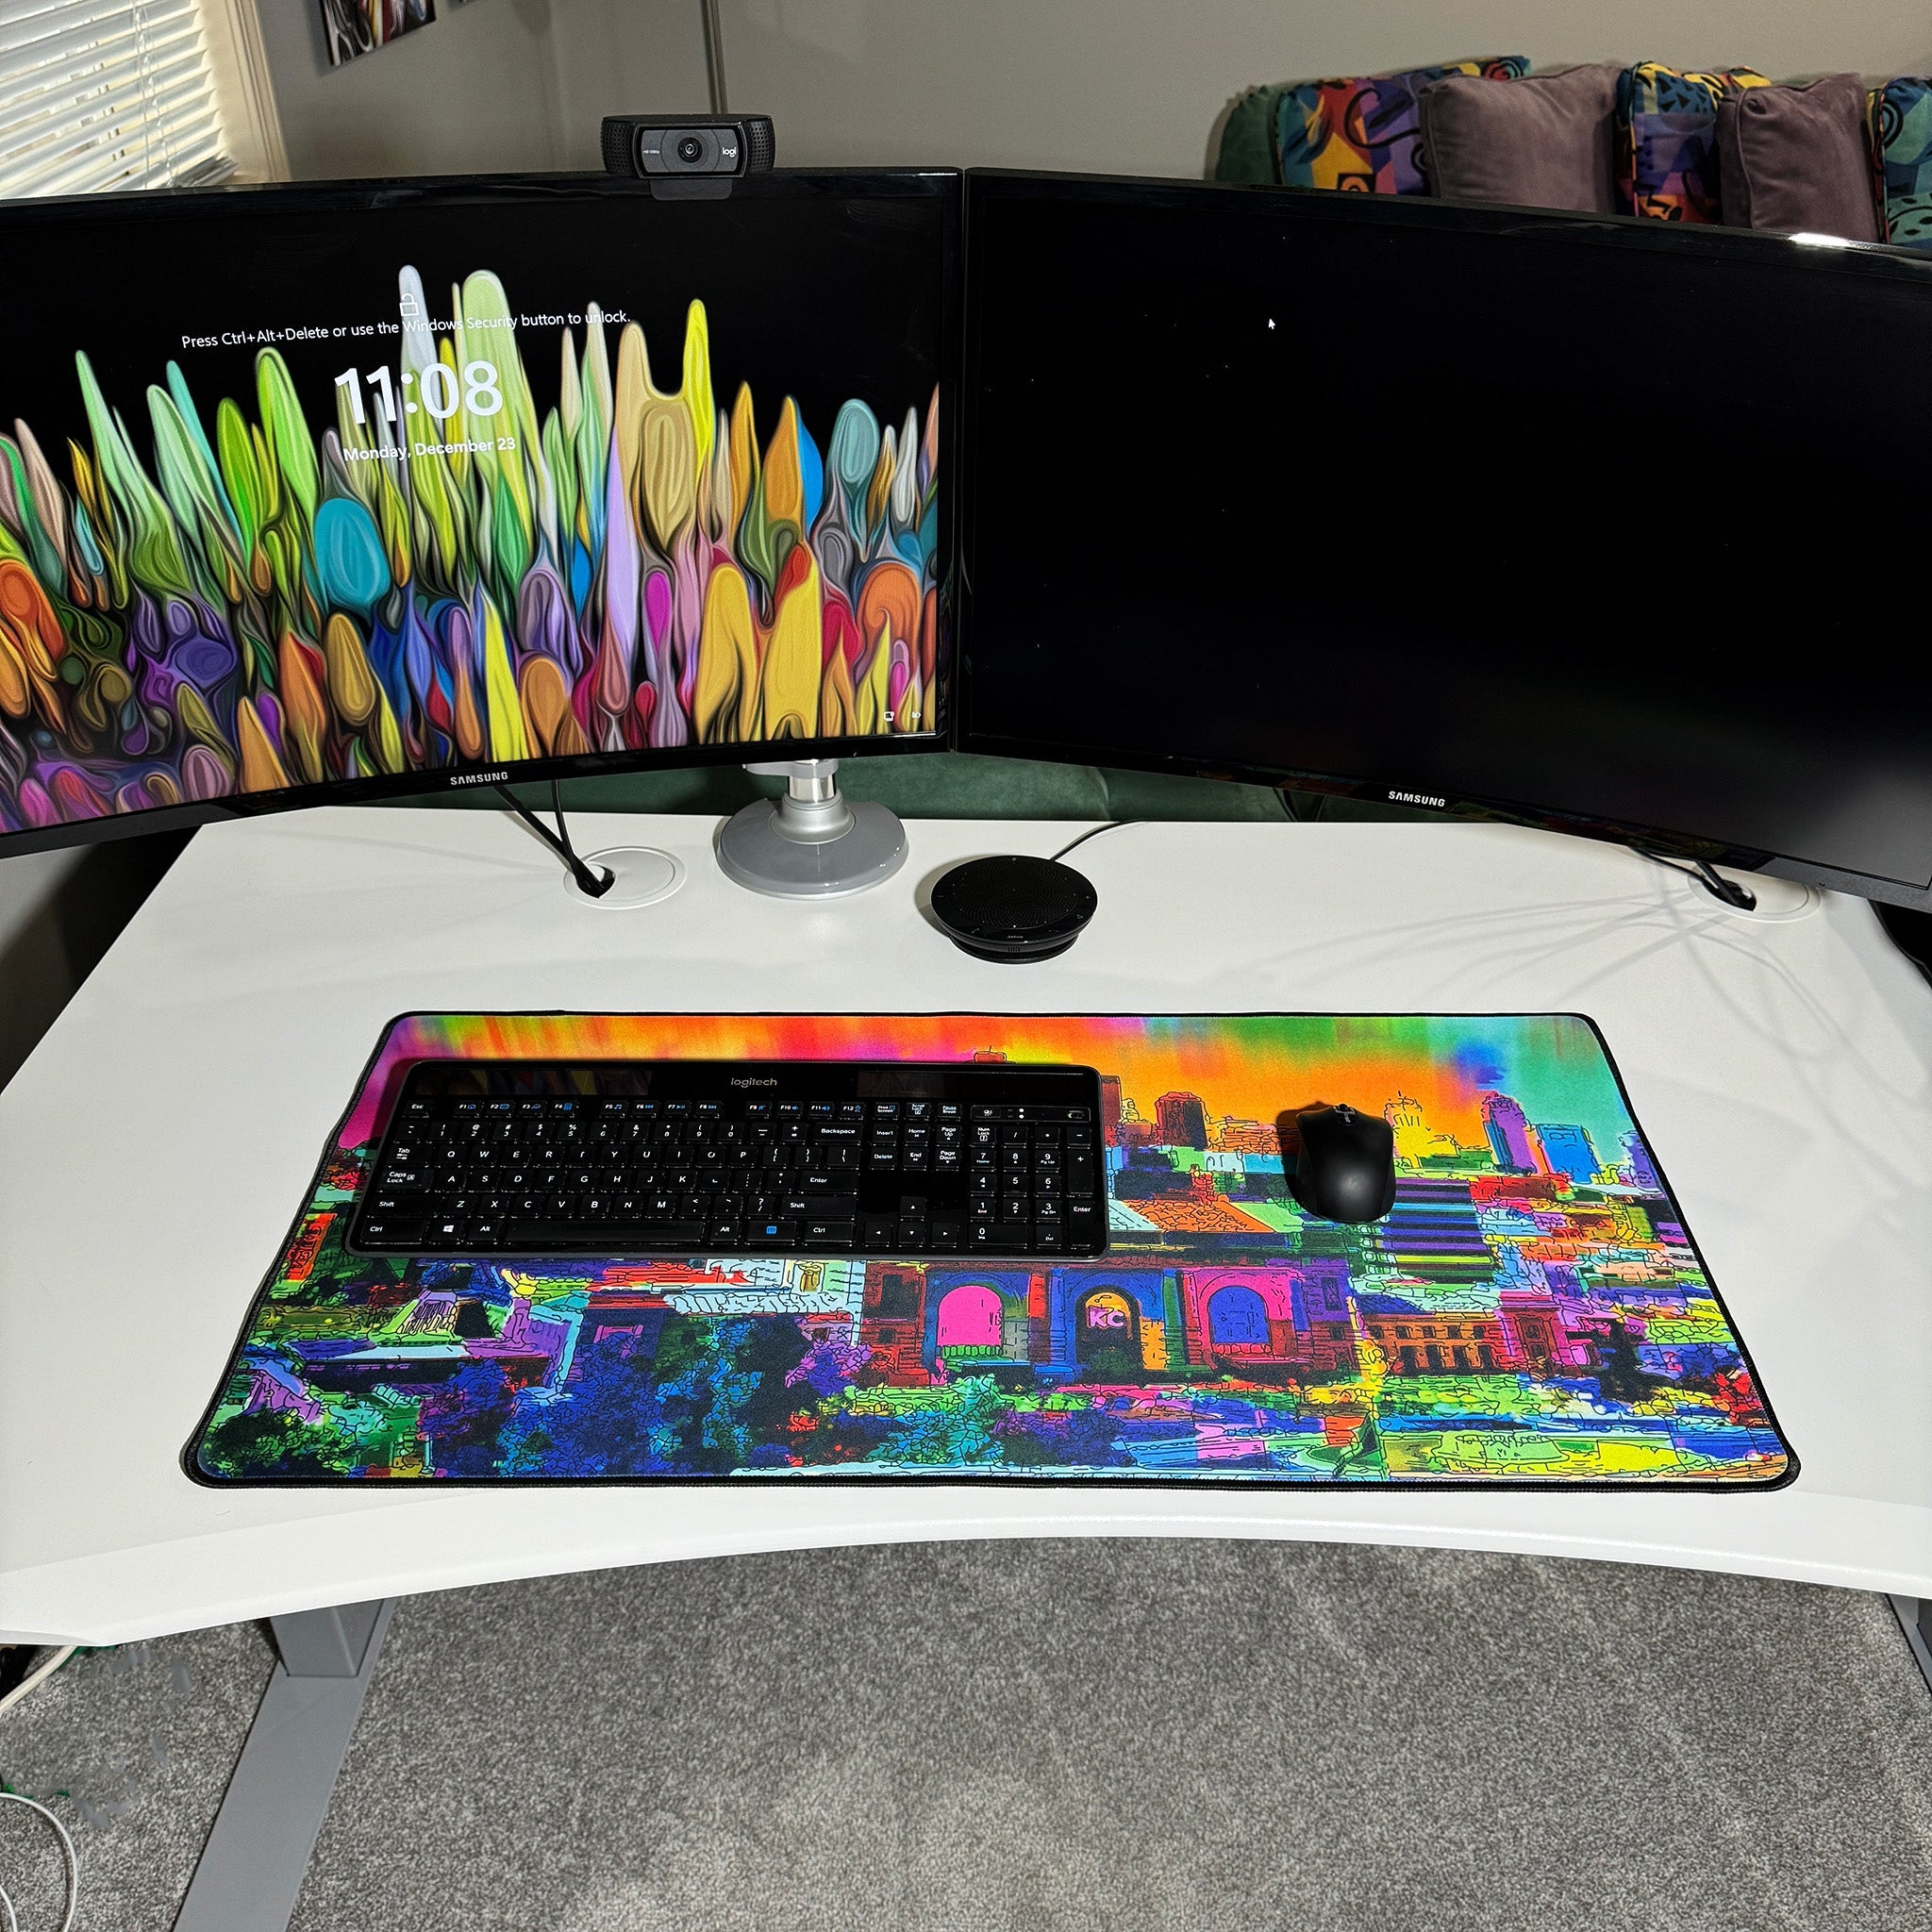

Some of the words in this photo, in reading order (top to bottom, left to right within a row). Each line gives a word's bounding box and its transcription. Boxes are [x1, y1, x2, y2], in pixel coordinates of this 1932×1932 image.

[722, 146, 737, 158] logi
[181, 335, 219, 349] Press
[221, 325, 329, 345] Ctrl+Alt+Delete
[332, 326, 347, 338] or
[351, 325, 375, 336] use
[377, 321, 399, 334] the
[402, 318, 464, 333] Windows
[466, 316, 518, 330] Security
[522, 312, 561, 326] button
[567, 312, 581, 325] to
[585, 309, 631, 324] unlock.
[334, 360, 503, 425] 11:08
[343, 444, 411, 461] Monday,
[414, 438, 493, 456] December
[497, 437, 516, 451] 23
[450, 772, 508, 786] SAMSUNG
[1388, 791, 1446, 808] SAMSUNG
[730, 1077, 778, 1089] logitech
[479, 1150, 490, 1158] W
[512, 1150, 521, 1158] E
[545, 1150, 553, 1158] R
[642, 1150, 651, 1158] U
[1012, 1152, 1019, 1160] 8
[481, 1174, 489, 1183] S
[513, 1174, 523, 1183] D
[1012, 1176, 1019, 1185] 5
[456, 1200, 466, 1208] Z
[490, 1200, 499, 1208] X
[524, 1200, 532, 1208] C
[558, 1200, 566, 1208] V
[591, 1200, 599, 1208] B
[657, 1200, 667, 1208] M
[1012, 1202, 1019, 1210] 2
[1045, 1202, 1052, 1210] 3
[978, 1227, 986, 1236] 0
[1089, 1307, 1125, 1327] KC
